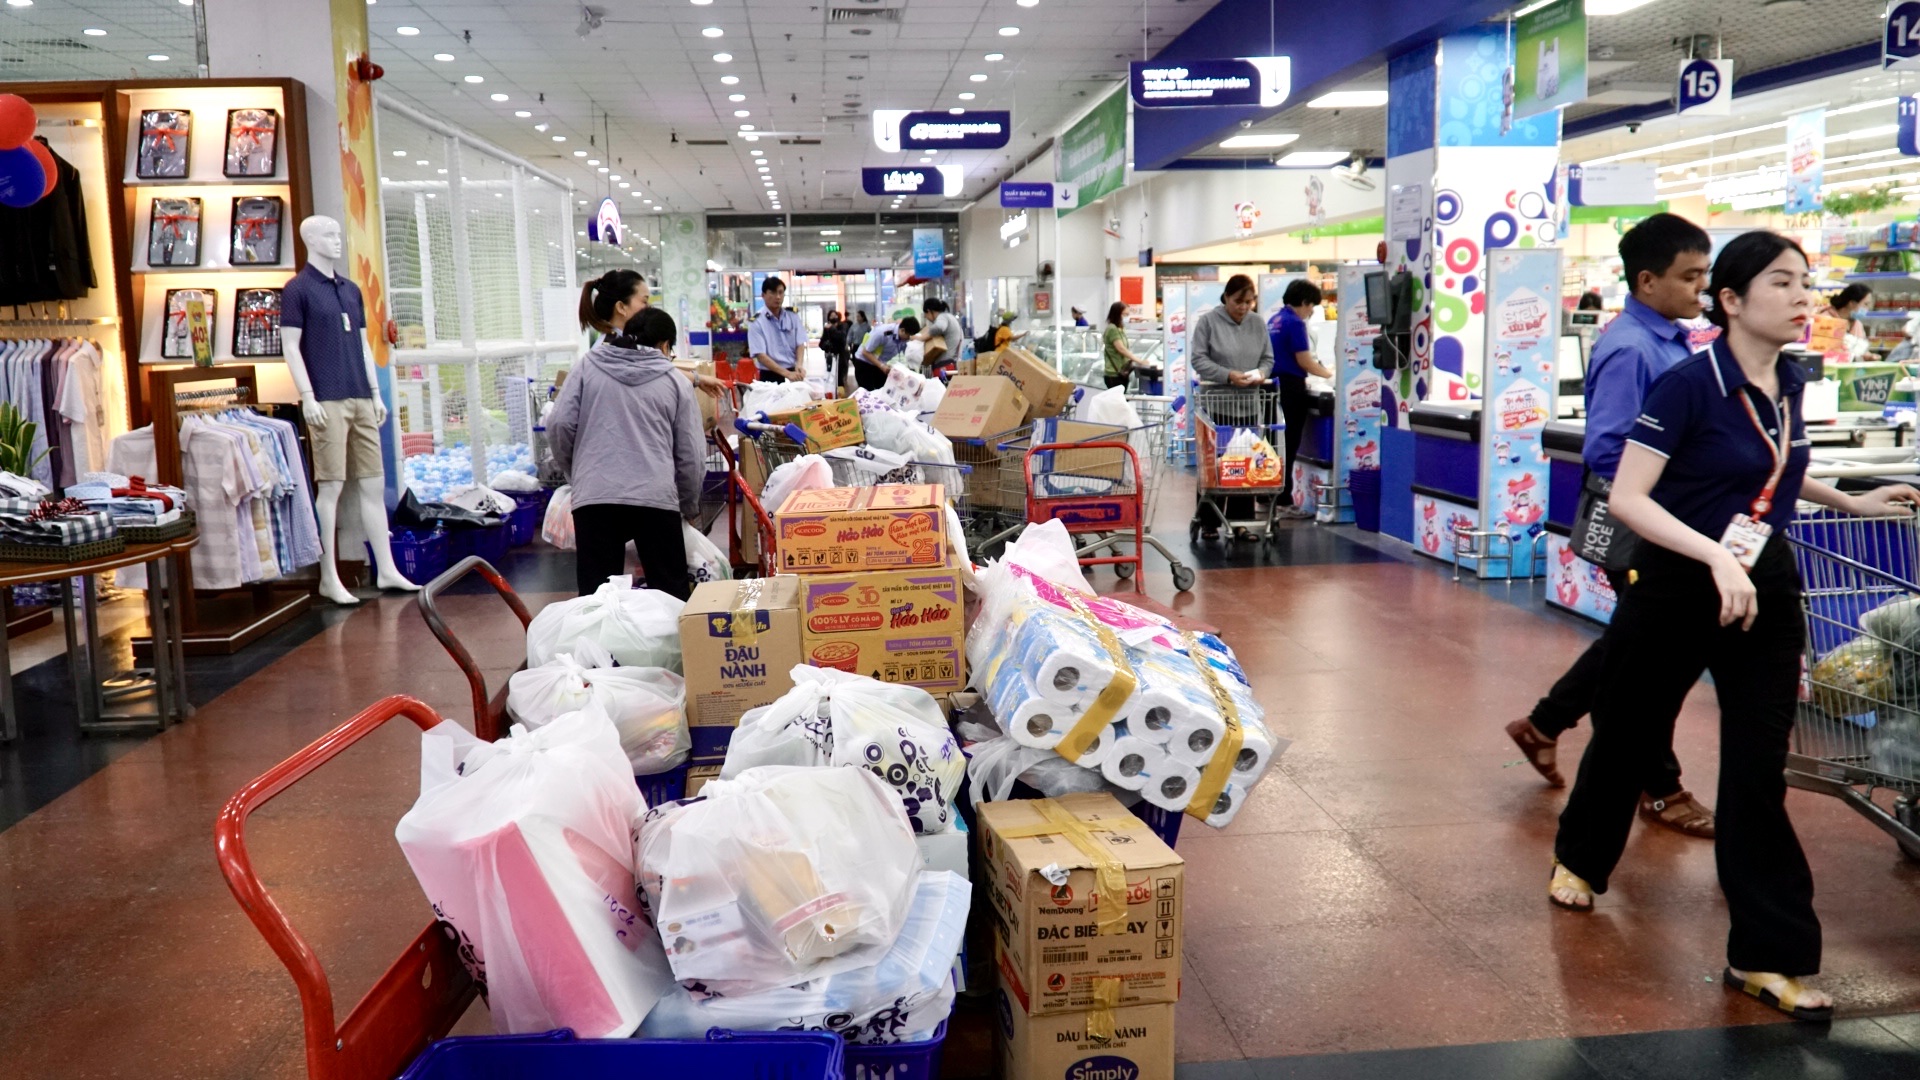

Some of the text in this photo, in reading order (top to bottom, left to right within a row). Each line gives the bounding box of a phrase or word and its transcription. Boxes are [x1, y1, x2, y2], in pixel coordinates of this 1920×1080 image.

[1891, 14, 1920, 47] 14
[1684, 70, 1718, 98] 15
[1900, 101, 1917, 116] 11
[1569, 168, 1582, 179] 12
[996, 364, 1024, 391] Select
[948, 387, 981, 398] Happy
[1230, 467, 1245, 475] OMO
[1582, 500, 1609, 556] NORTH
[911, 537, 936, 557] 25
[1593, 526, 1615, 563] FACE
[813, 616, 838, 625] 100%
[839, 615, 850, 624] LY
[890, 603, 950, 630] Hảo Hảo
[724, 645, 760, 663] ĐẬU
[720, 662, 767, 680] NÀNH
[1037, 921, 1148, 942] ĐẶC BIỆ AY
[1072, 1061, 1133, 1080] Simply
